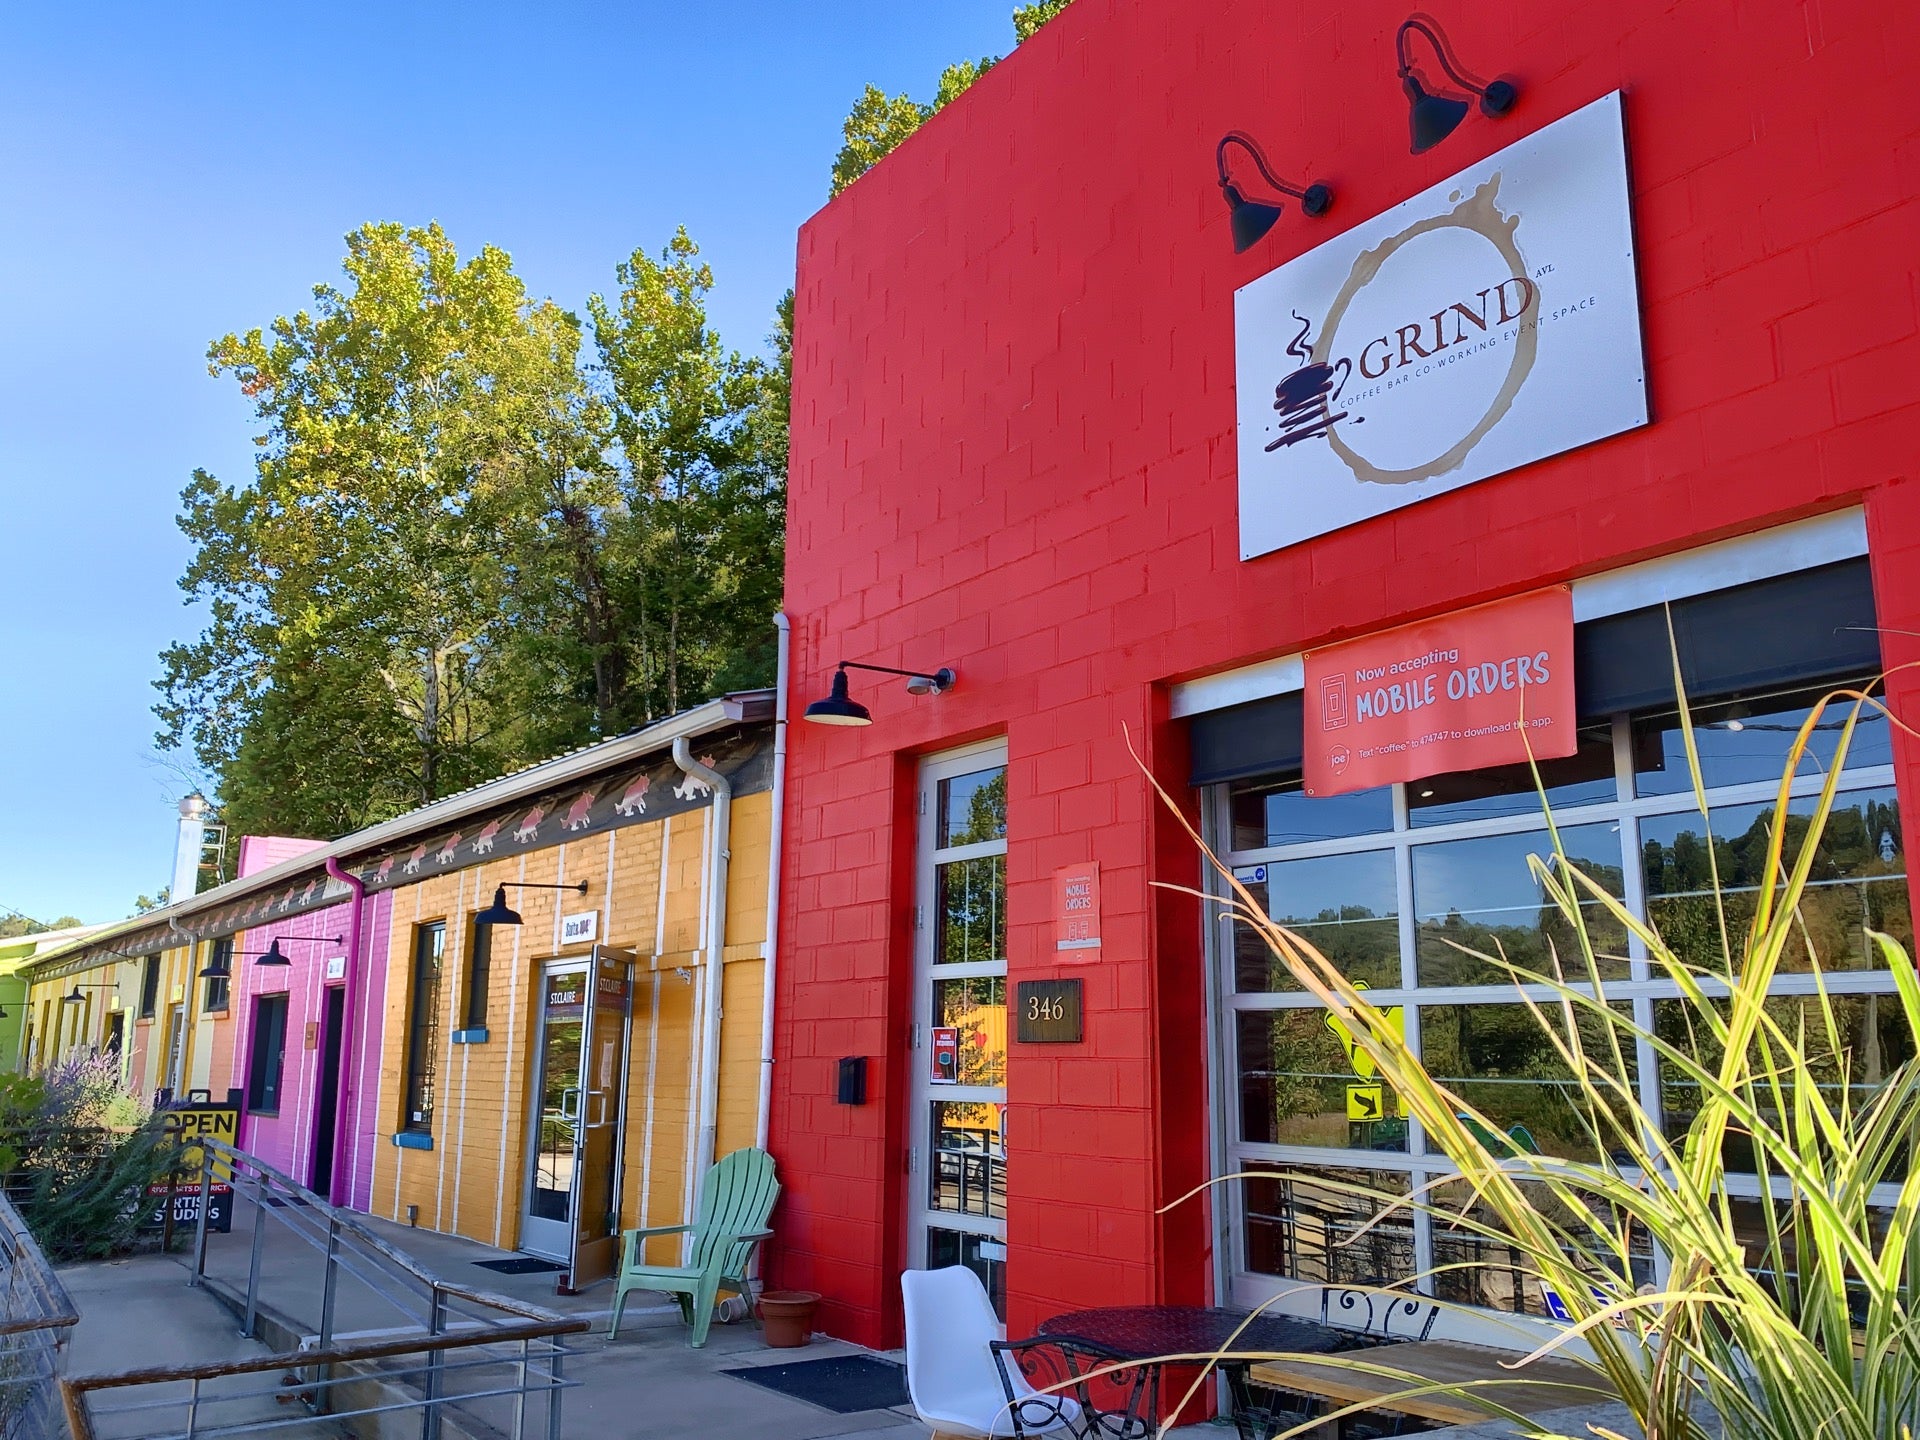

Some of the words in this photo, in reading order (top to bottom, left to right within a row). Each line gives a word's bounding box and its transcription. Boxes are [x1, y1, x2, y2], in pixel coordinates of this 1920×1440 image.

[1535, 264, 1555, 278] AVL
[1360, 277, 1533, 379] GRIND
[1340, 386, 1381, 409] COFFEE
[1387, 374, 1409, 389] BAR
[1415, 337, 1496, 377] CO-WORKING
[1504, 317, 1544, 341] EVENT
[1552, 296, 1596, 321] SPACE
[1356, 667, 1386, 683] Now
[1389, 648, 1459, 675] accepting
[1356, 673, 1437, 723] MOBILE
[1447, 651, 1550, 700] ORDERS
[1359, 748, 1374, 758] Text
[1411, 738, 1419, 748] to
[1451, 729, 1462, 739] to
[1464, 721, 1511, 738] download
[1532, 716, 1554, 728] app.
[1331, 754, 1346, 769] joe
[1065, 882, 1090, 898] MOBILE
[1065, 896, 1092, 911] ORDERS
[1027, 996, 1065, 1021] 346
[162, 1113, 234, 1134] OPEN
[194, 1184, 228, 1192] DIRICT
